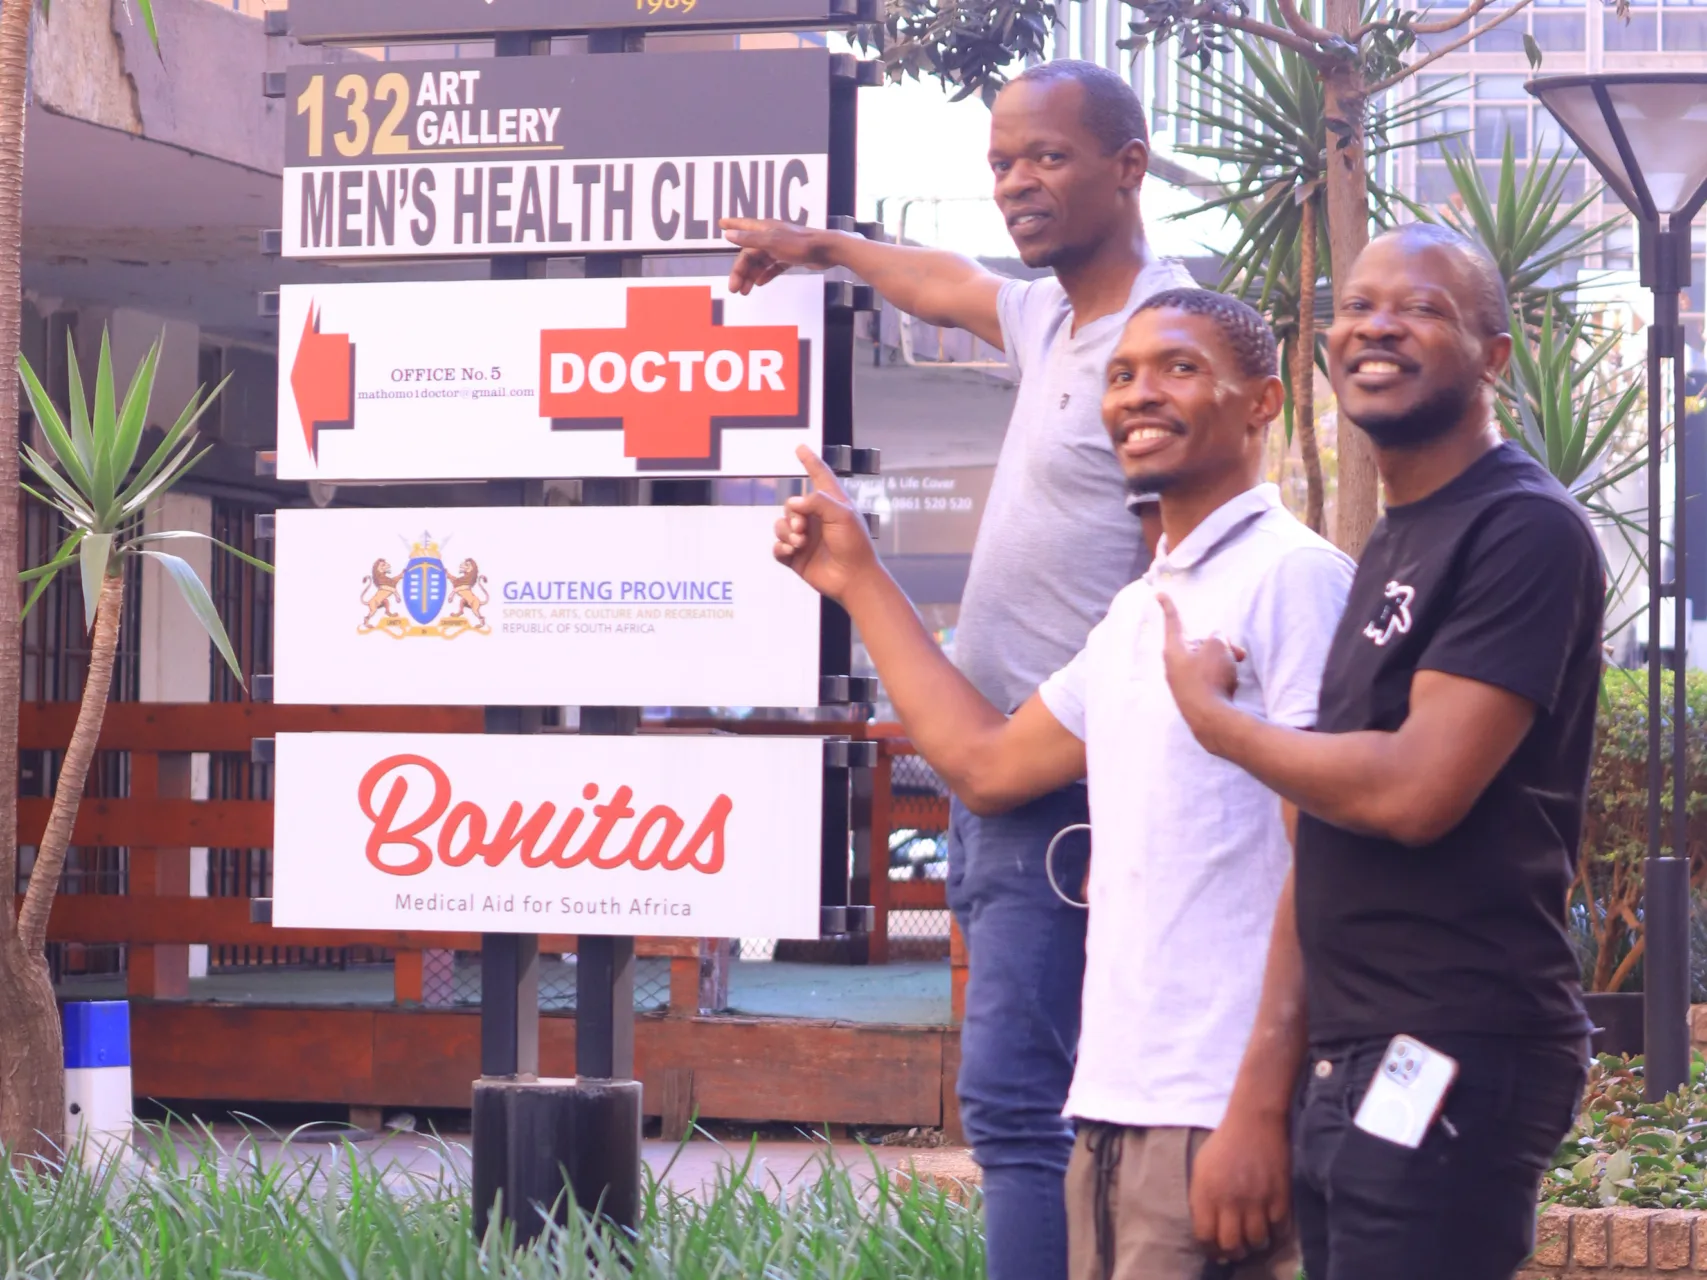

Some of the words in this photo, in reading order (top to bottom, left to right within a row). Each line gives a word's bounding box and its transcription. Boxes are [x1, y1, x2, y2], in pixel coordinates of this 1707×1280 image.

[416, 70, 481, 106] ART
[297, 72, 410, 157] 132
[416, 107, 561, 146] GALLERY
[300, 167, 437, 248] MEN'S
[453, 164, 634, 245] HEALTH
[651, 158, 809, 242] CLINIC
[391, 368, 456, 382] OFFICE
[461, 367, 487, 381] No.
[490, 366, 502, 381] 5
[550, 349, 786, 394] DOCTOR
[503, 581, 613, 600] GAUTENG
[620, 581, 733, 600] PROVINCE
[502, 608, 547, 620] SPORTS,
[550, 608, 581, 620] ARTS,
[584, 608, 632, 619] CULTURE
[636, 608, 662, 619] AND
[664, 608, 734, 619] RECREATION
[502, 623, 553, 633] REPUBLIC
[556, 623, 571, 633] OF
[574, 623, 612, 633] SOUTH
[615, 623, 656, 633] AFRICA
[357, 753, 733, 876] Bonitas
[395, 893, 475, 912] Medical
[482, 895, 515, 913] Aid
[522, 895, 553, 913] for
[560, 896, 621, 915] South
[628, 897, 692, 916] Africa
